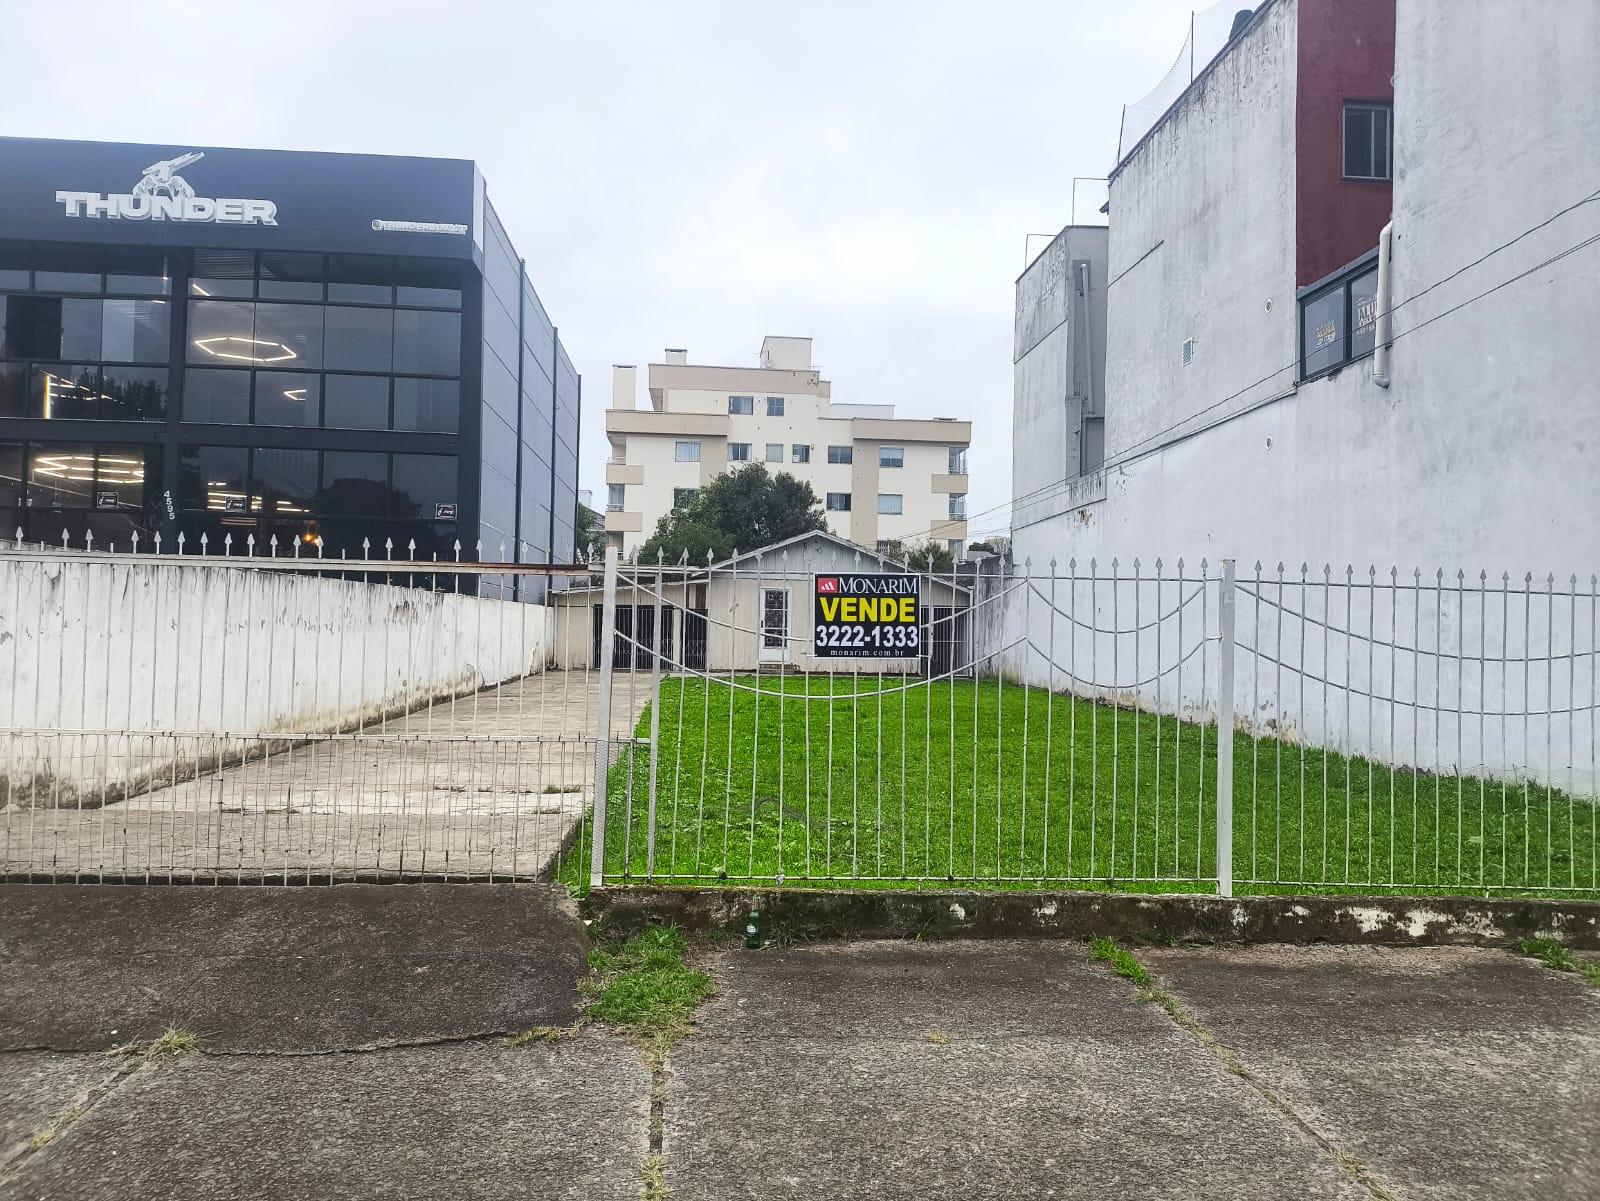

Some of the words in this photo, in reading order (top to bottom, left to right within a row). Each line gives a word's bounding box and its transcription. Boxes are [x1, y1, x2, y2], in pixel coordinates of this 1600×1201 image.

[55, 190, 279, 226] THUNDER
[163, 490, 176, 520] 4595
[838, 577, 917, 594] MONARIM
[819, 597, 916, 622] VENDE
[816, 625, 918, 648] 3222-1333
